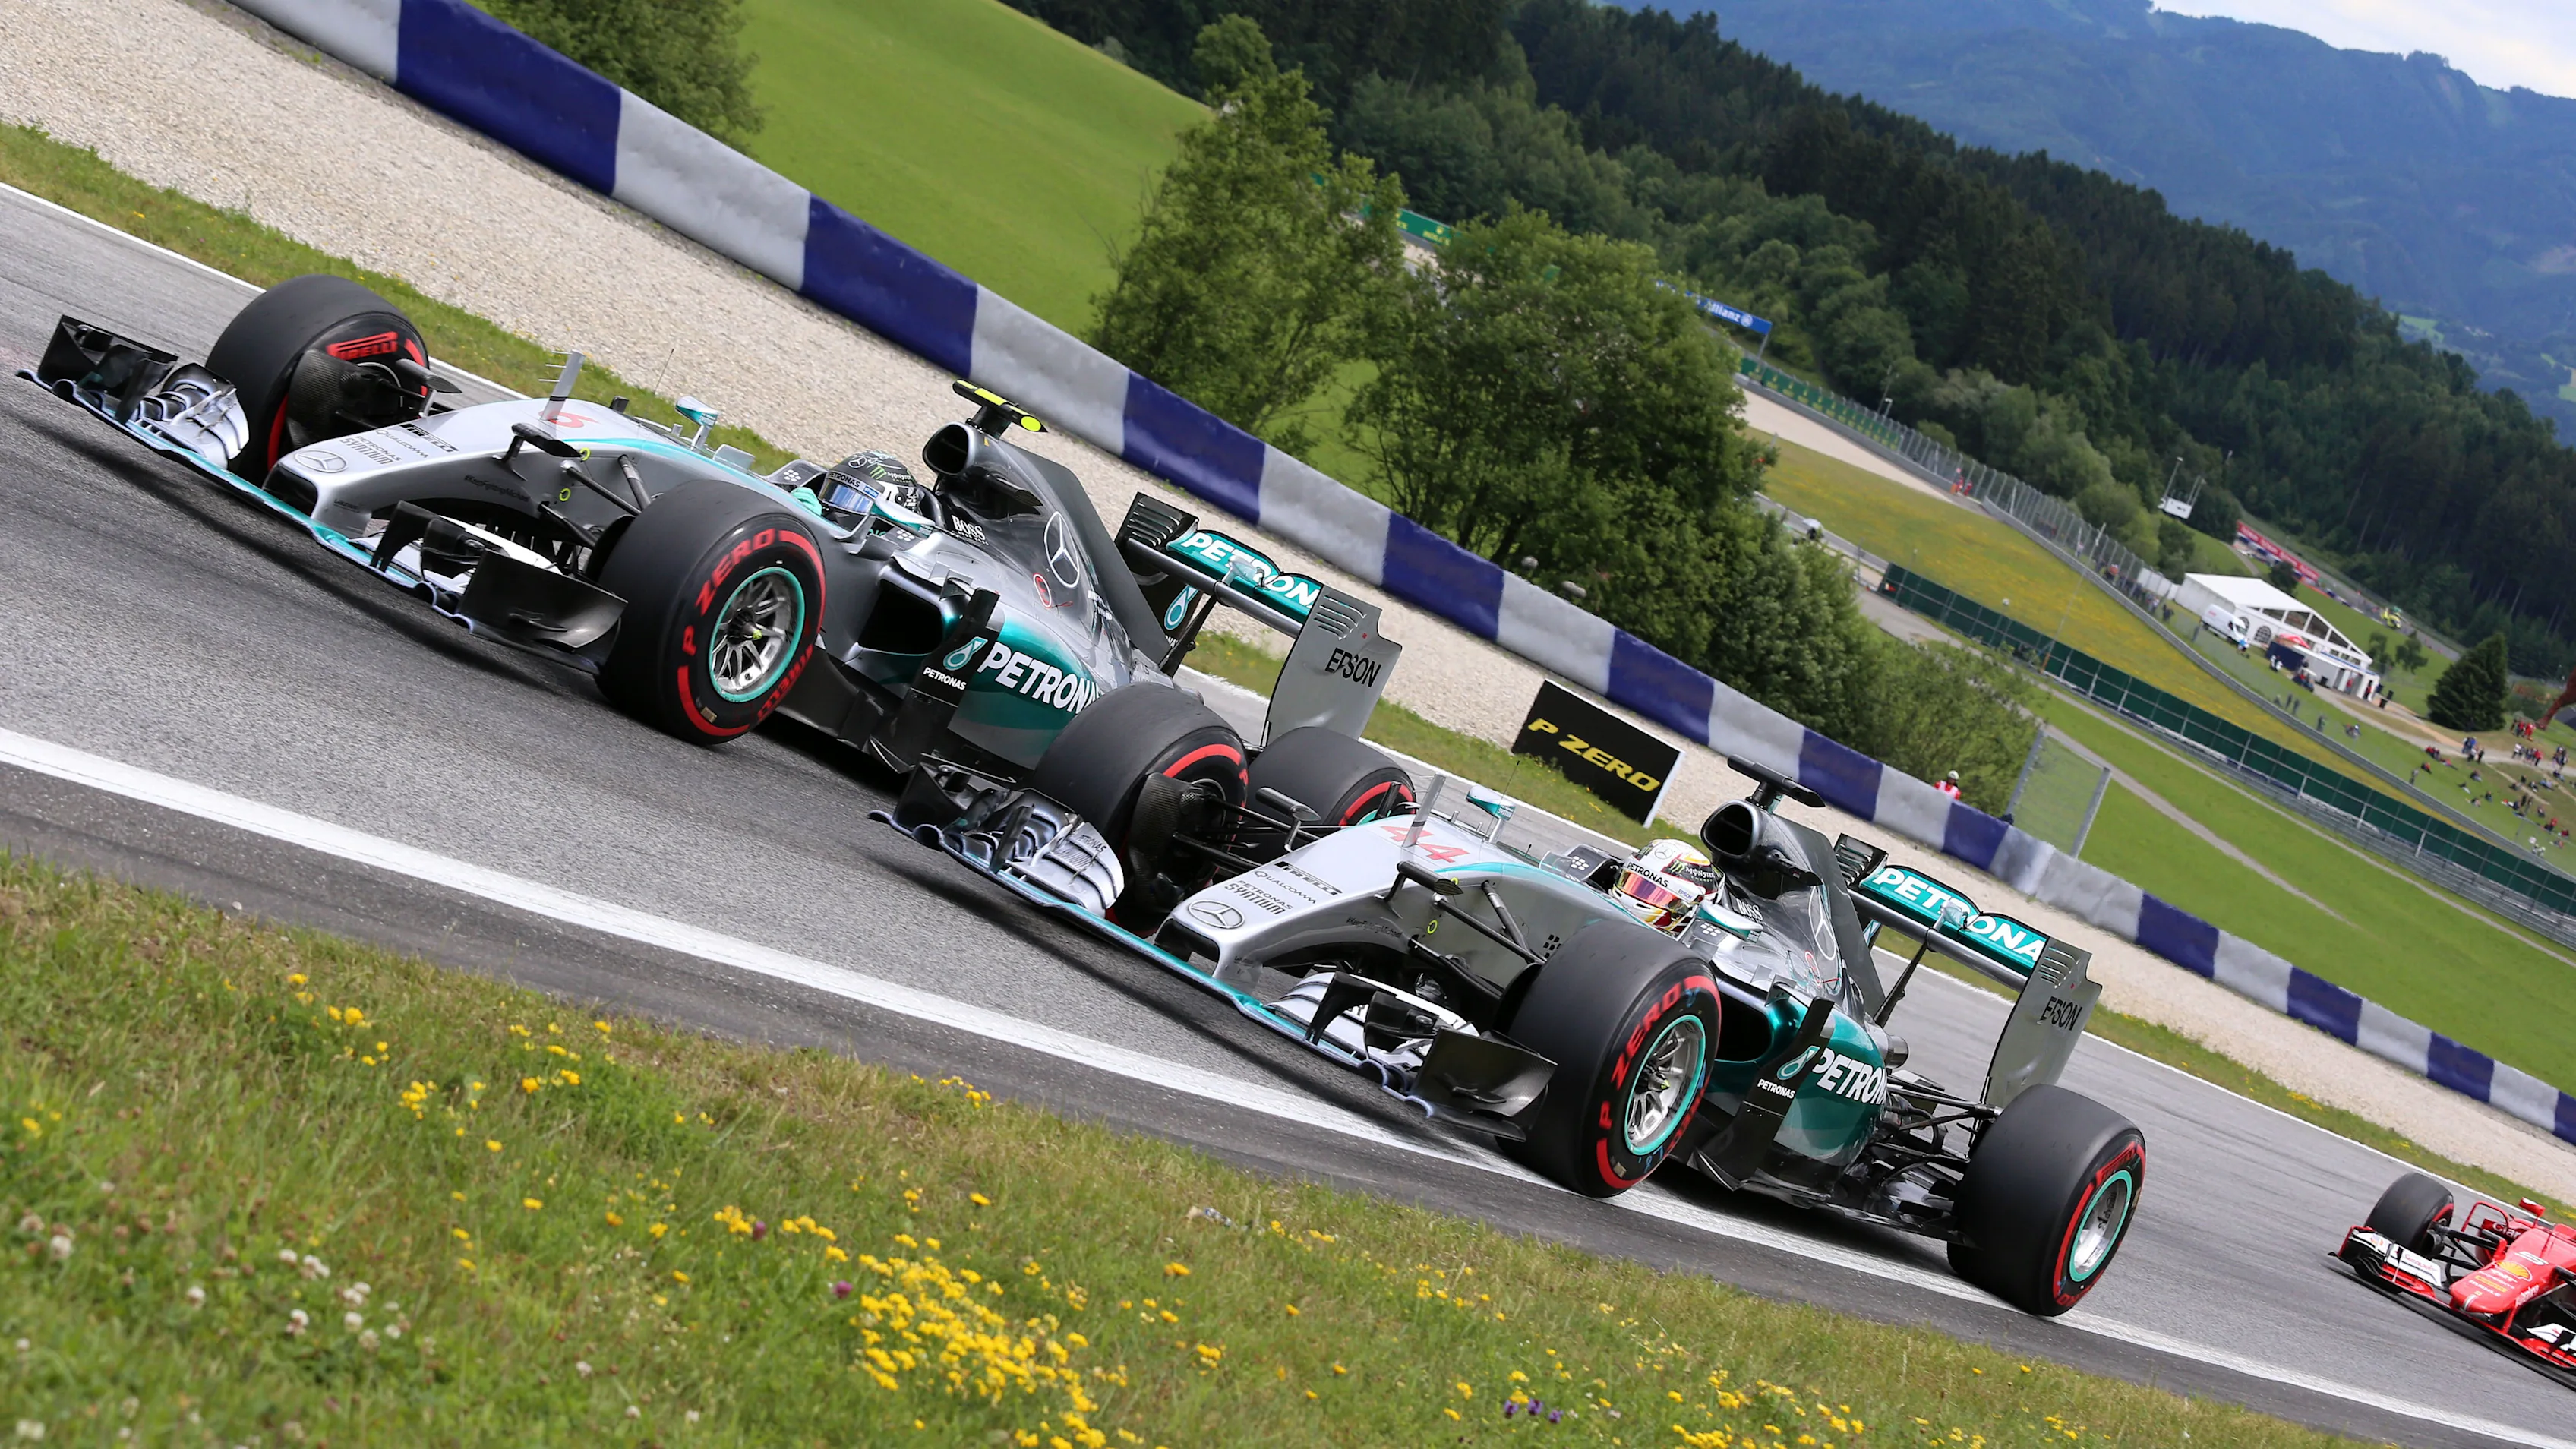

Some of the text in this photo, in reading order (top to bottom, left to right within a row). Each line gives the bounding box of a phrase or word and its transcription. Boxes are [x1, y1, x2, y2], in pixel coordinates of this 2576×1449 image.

[399, 423, 459, 453] PIRELLI
[829, 471, 861, 488] PETRONAS
[952, 515, 986, 541] BOSS
[682, 527, 775, 656] P ZERO
[923, 667, 967, 691] PETRONAS
[1324, 647, 1382, 687] EPSON
[1528, 718, 1661, 792] P ZERO
[1379, 825, 1471, 864] 44
[1254, 870, 1317, 904] QUALCOMM
[1274, 860, 1343, 895] PIRELLI
[1627, 862, 1669, 888] PETRONAS
[1224, 882, 1286, 915] SYNTIUM
[1237, 879, 1294, 910] PETRONAS
[1599, 983, 1681, 1130] P ZERO
[1757, 1078, 1796, 1100] PETRONAS
